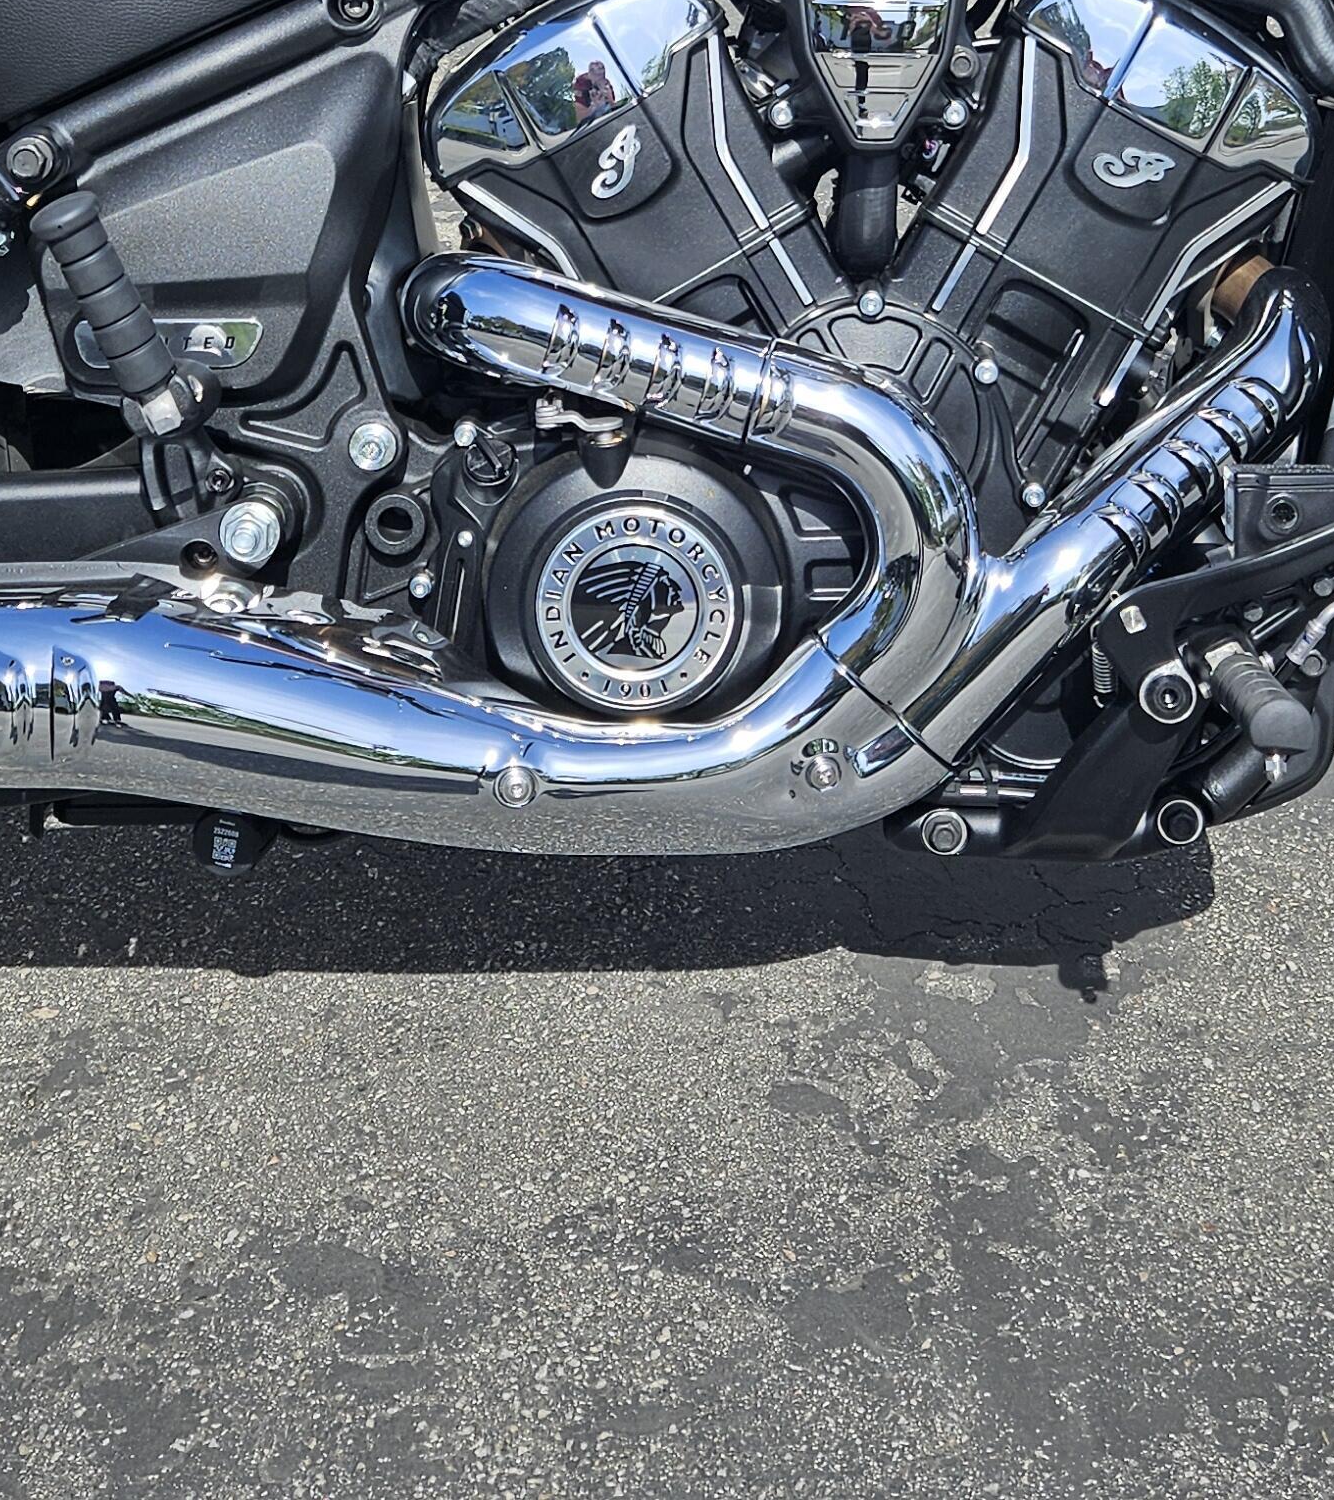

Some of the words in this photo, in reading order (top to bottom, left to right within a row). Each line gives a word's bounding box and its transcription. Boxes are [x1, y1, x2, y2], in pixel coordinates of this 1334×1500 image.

[545, 541, 586, 666] INDIAN
[594, 516, 727, 667] MOTORCYCLE
[602, 678, 670, 700] 1901
